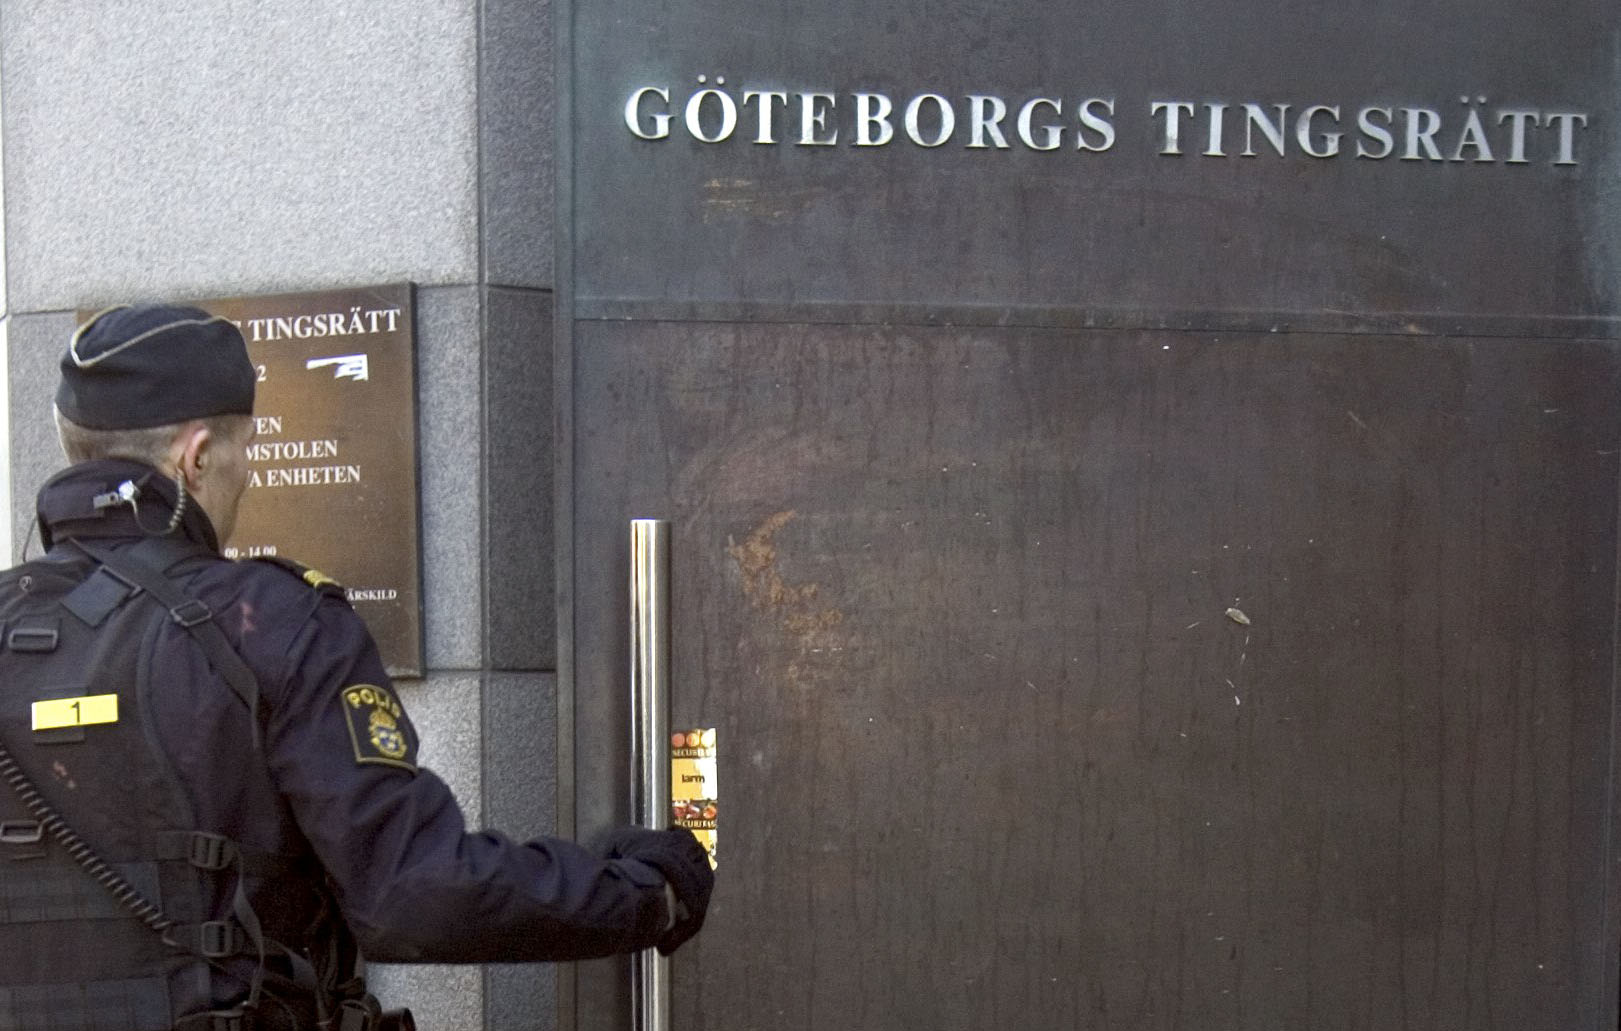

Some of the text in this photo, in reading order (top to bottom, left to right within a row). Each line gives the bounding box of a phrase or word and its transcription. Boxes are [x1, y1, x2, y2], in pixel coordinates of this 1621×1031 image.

[624, 74, 1588, 166] GÖTEBORGS TINGSRÄTT
[248, 306, 400, 341] TINGSRÄTT
[253, 416, 282, 435] EN
[248, 465, 361, 488] A ENHETEN
[345, 588, 397, 602] ÄRSKILD
[70, 701, 80, 724] 1
[347, 688, 401, 718] POLIS
[681, 774, 705, 783] larm
